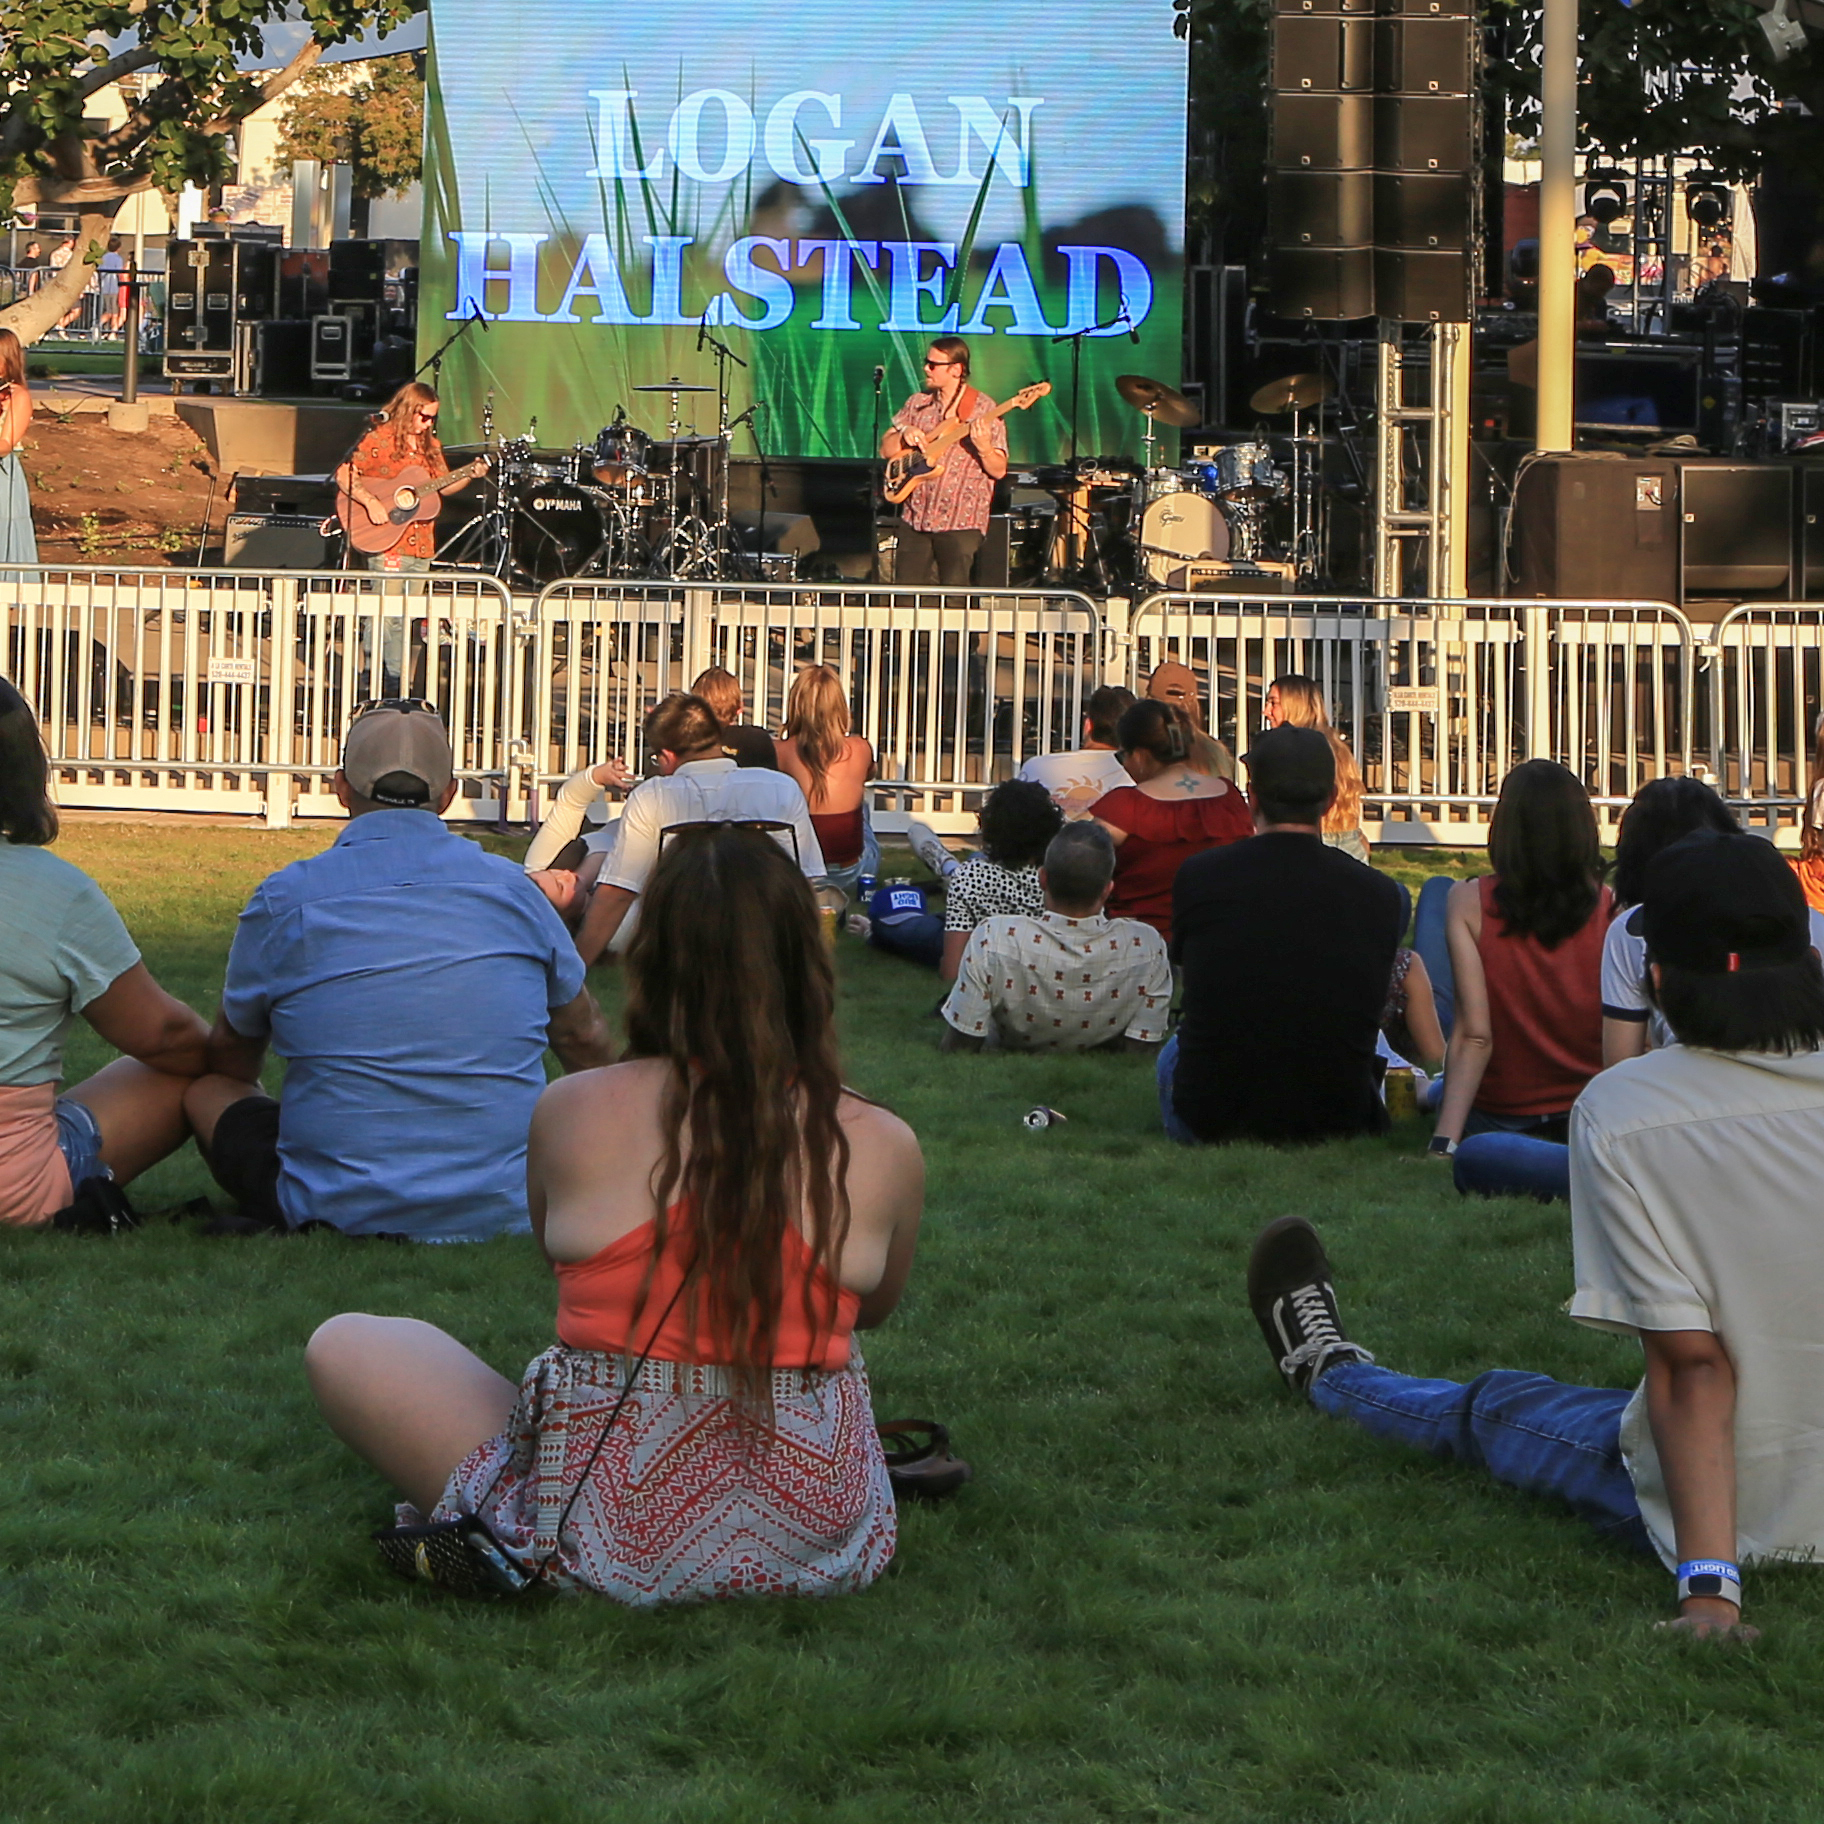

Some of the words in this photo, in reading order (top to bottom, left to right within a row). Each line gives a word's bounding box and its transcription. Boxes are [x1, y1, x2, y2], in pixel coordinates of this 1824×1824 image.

[586, 88, 1045, 188] LOGAN
[445, 231, 1155, 338] HALSTEAD
[893, 892, 919, 901] LIGHT
[897, 898, 917, 907] BUD
[1692, 1563, 1726, 1576] LIGHT
[1726, 1566, 1739, 1579] UD
